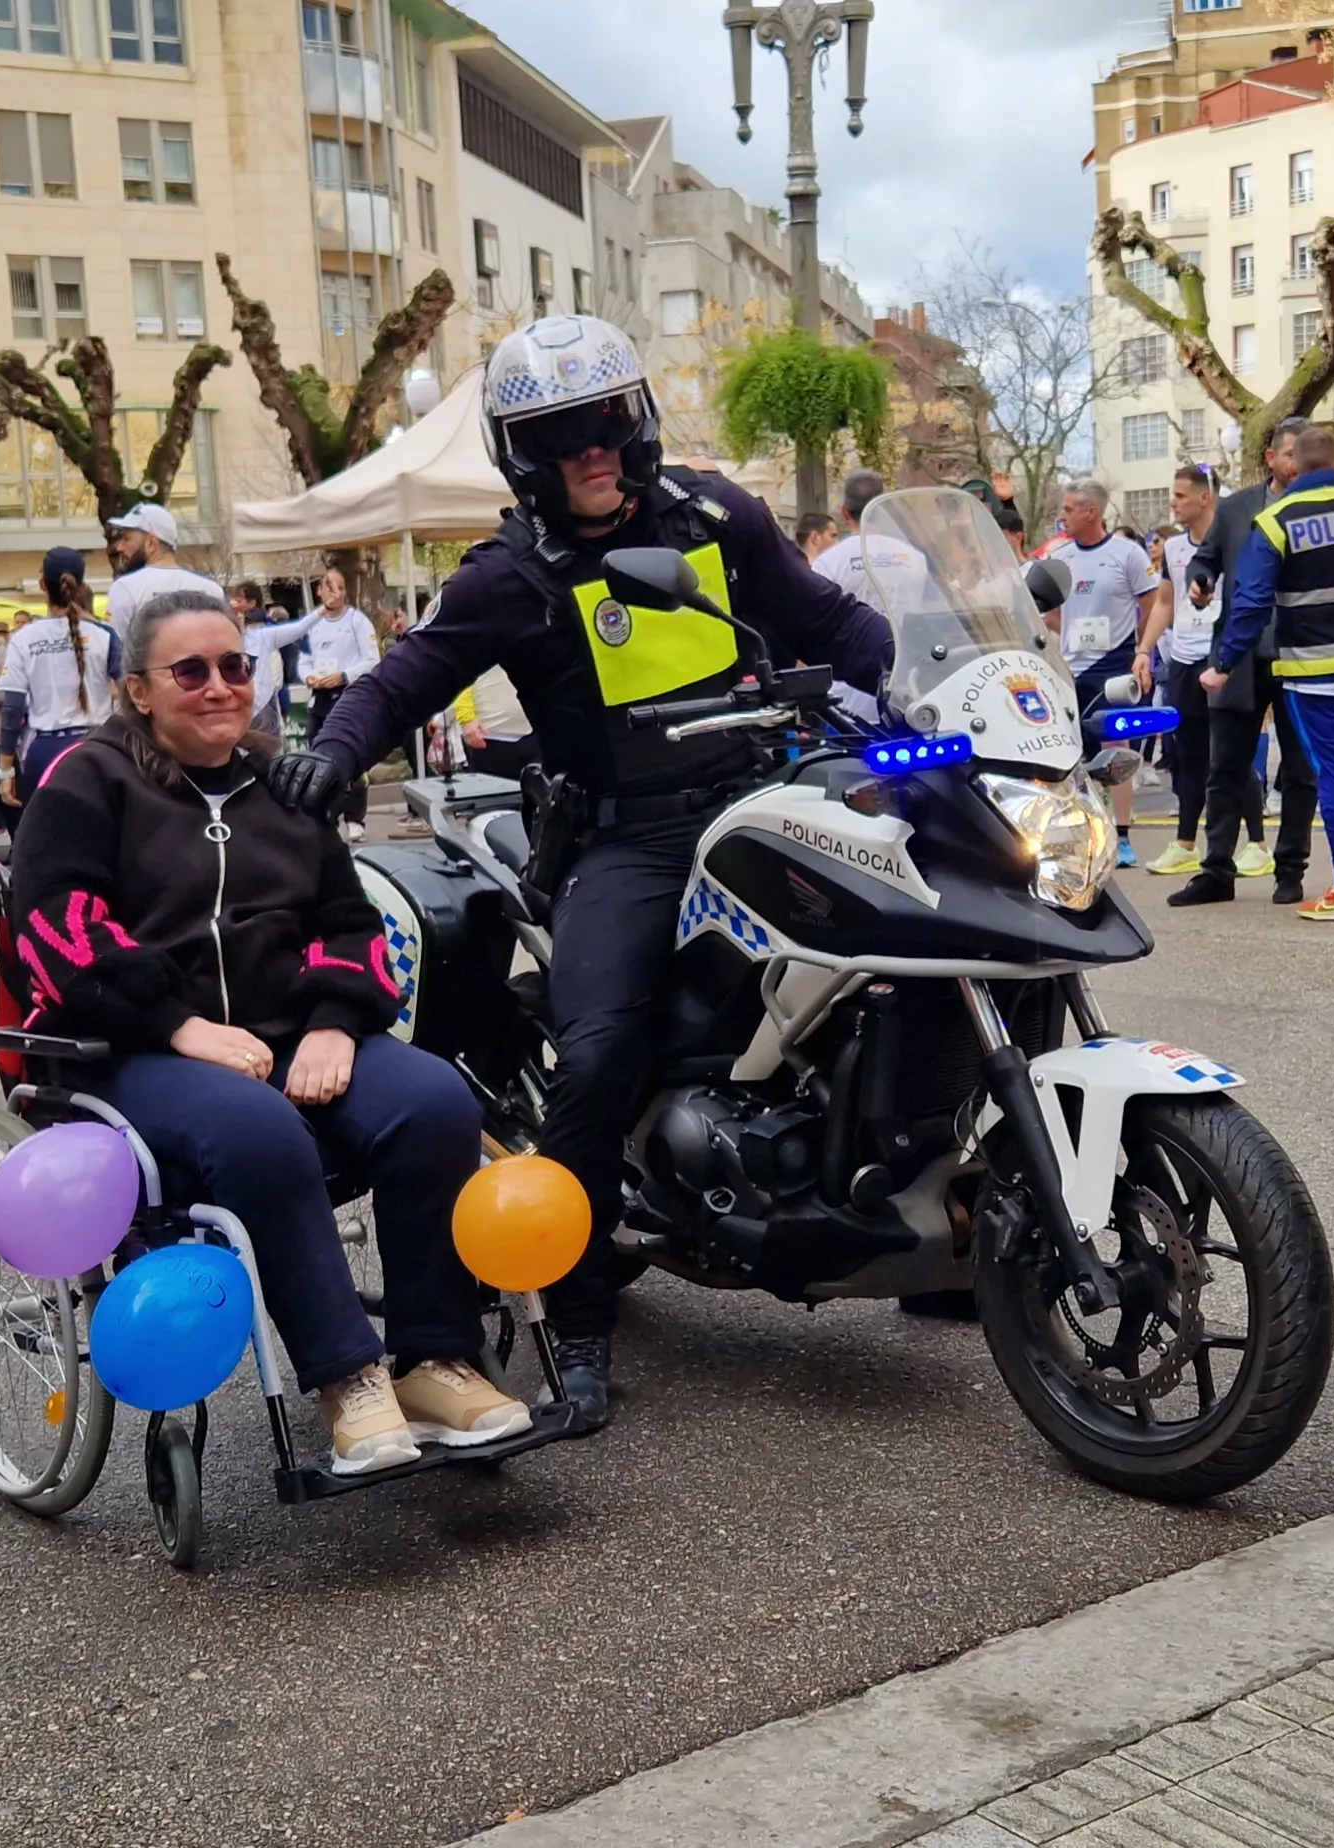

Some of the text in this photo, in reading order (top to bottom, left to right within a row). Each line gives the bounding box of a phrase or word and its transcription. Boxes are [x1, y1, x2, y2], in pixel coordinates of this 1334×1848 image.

[962, 657, 1010, 714] POLICIA
[783, 819, 906, 880] POLICIA LOCAL
